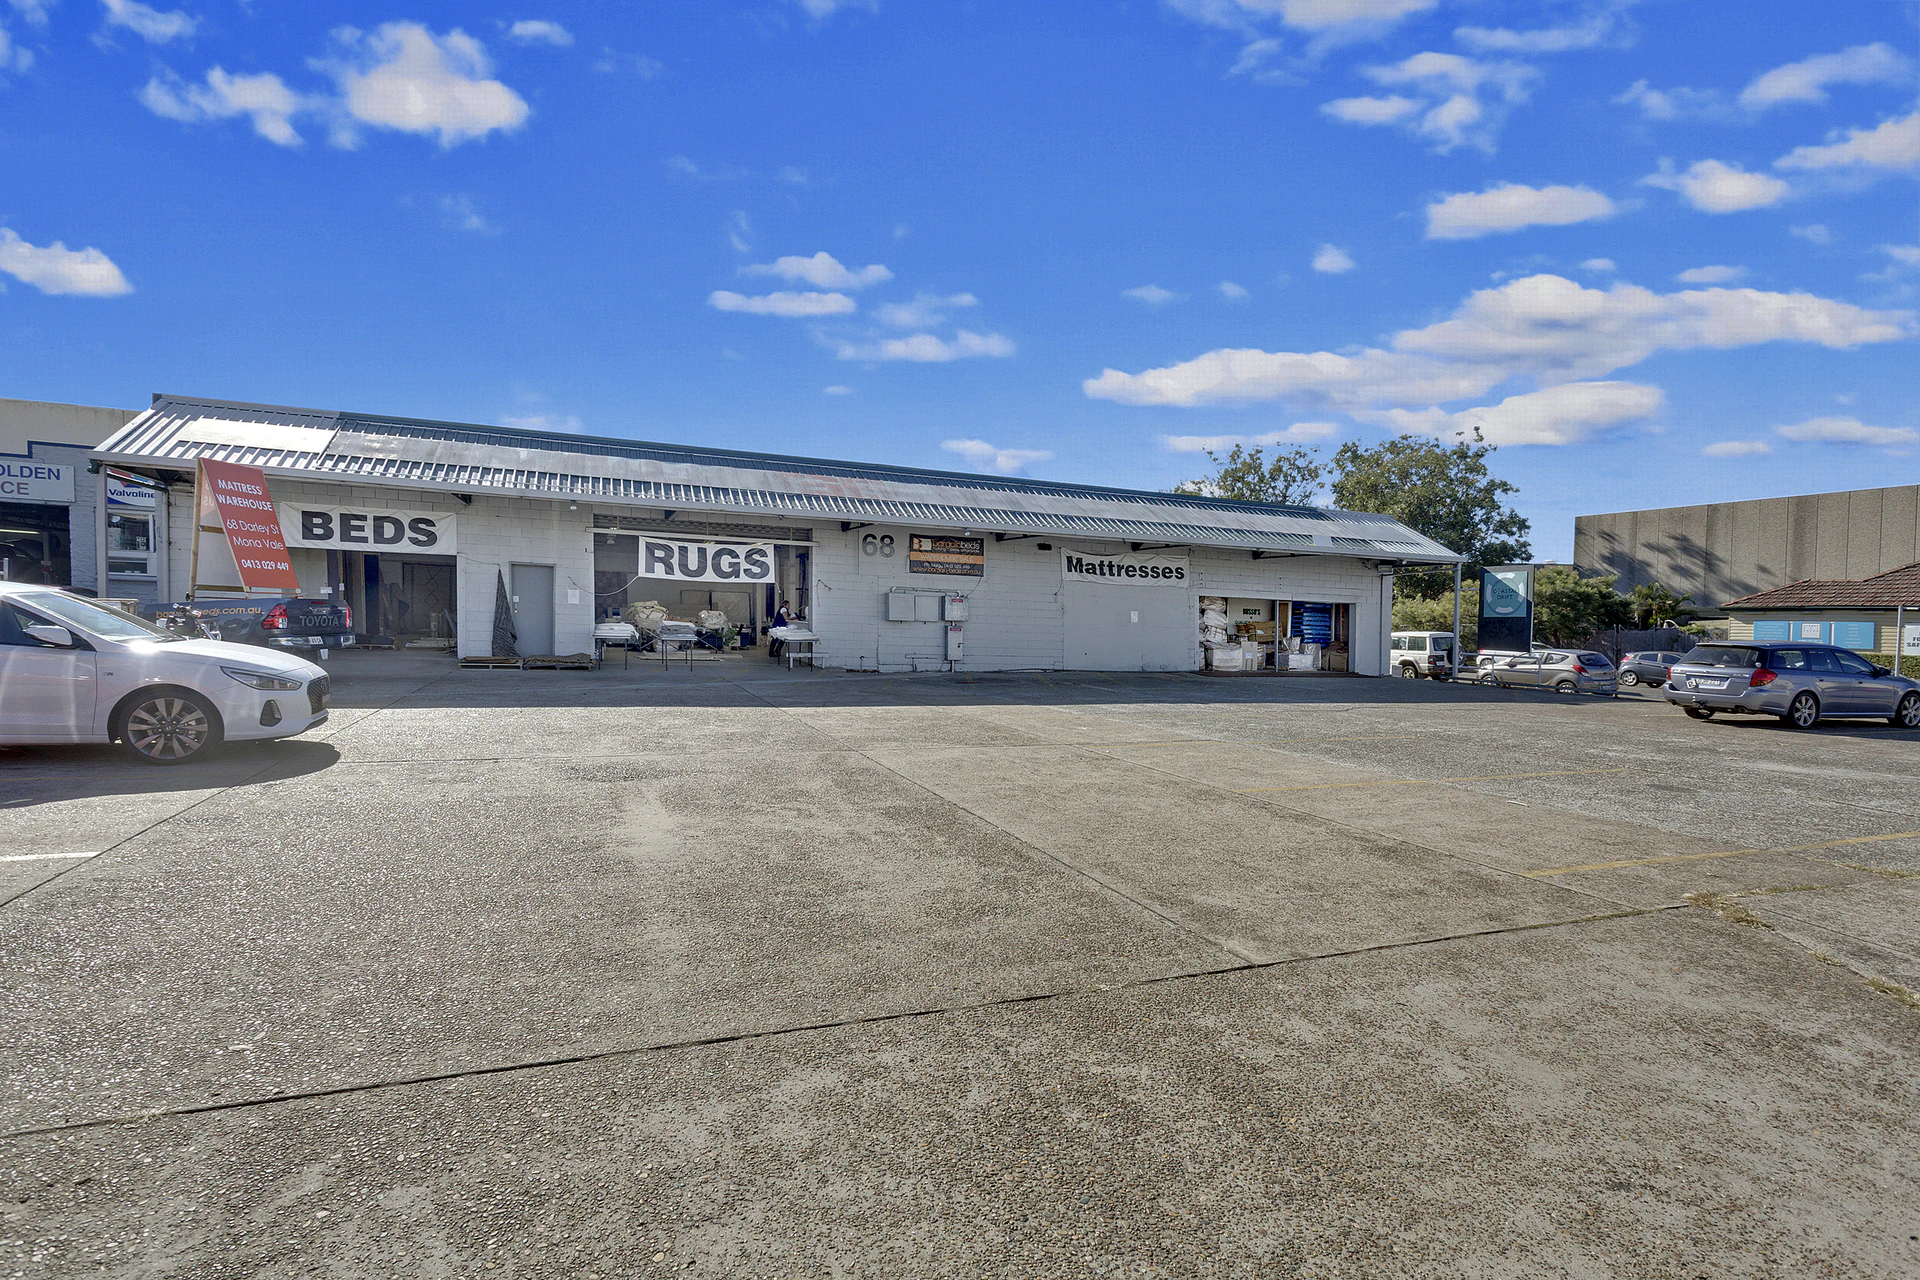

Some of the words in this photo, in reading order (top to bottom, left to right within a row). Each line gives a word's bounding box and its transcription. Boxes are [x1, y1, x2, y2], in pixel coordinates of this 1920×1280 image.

[218, 479, 262, 495] MATTRESS
[216, 494, 273, 511] WAREHOUSE
[226, 519, 238, 530] 68
[239, 520, 269, 535] Darley
[270, 524, 280, 535] St
[301, 510, 438, 547] BEDS
[232, 536, 262, 548] Mona
[262, 538, 284, 550] Vale
[862, 533, 895, 558] 68
[241, 559, 261, 569] 0413
[262, 560, 276, 570] 029
[277, 561, 289, 571] 449
[645, 542, 770, 579] RUGS
[1066, 555, 1185, 580] Mattresses
[300, 615, 339, 627] TOYOTA
